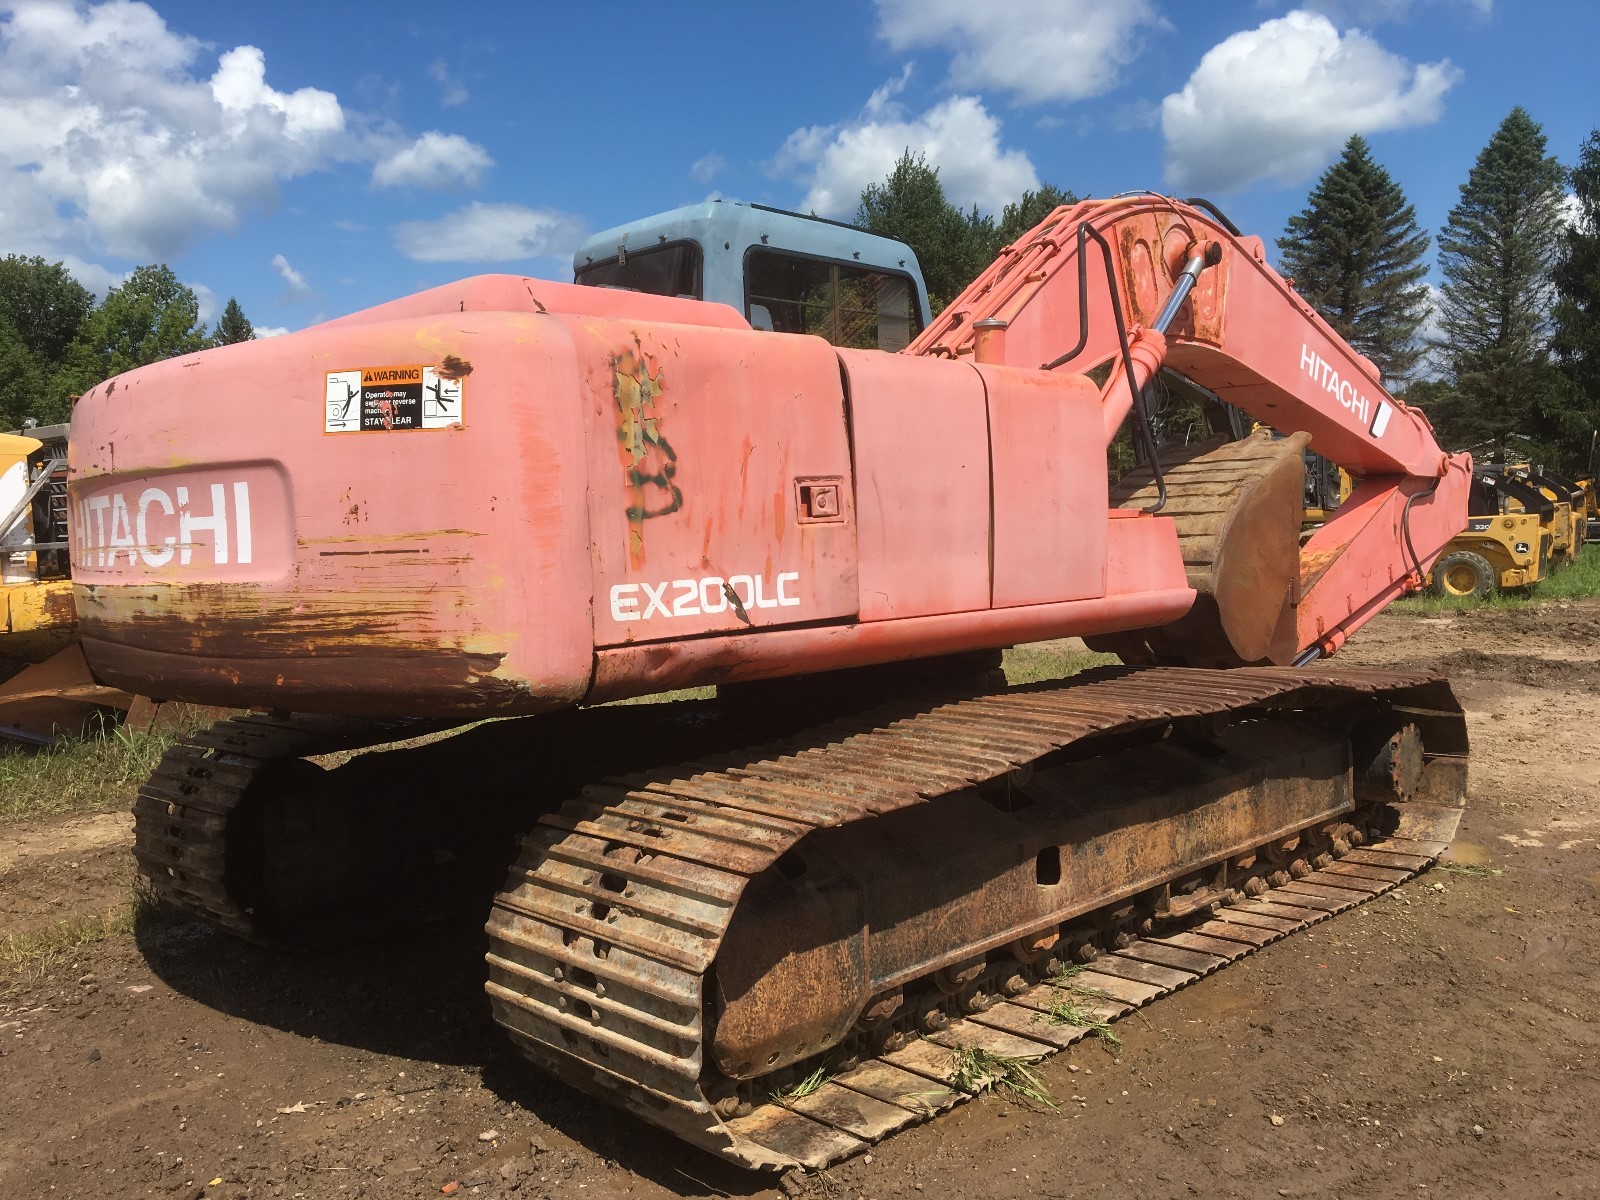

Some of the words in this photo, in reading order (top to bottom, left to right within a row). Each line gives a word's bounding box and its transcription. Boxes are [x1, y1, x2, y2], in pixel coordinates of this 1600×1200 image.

[373, 369, 419, 381] WARNING
[1300, 343, 1370, 425] HITACHI
[364, 417, 385, 426] STAY
[385, 416, 412, 425] LEAR
[74, 481, 252, 568] HITACHI
[609, 571, 801, 622] EX200LC
